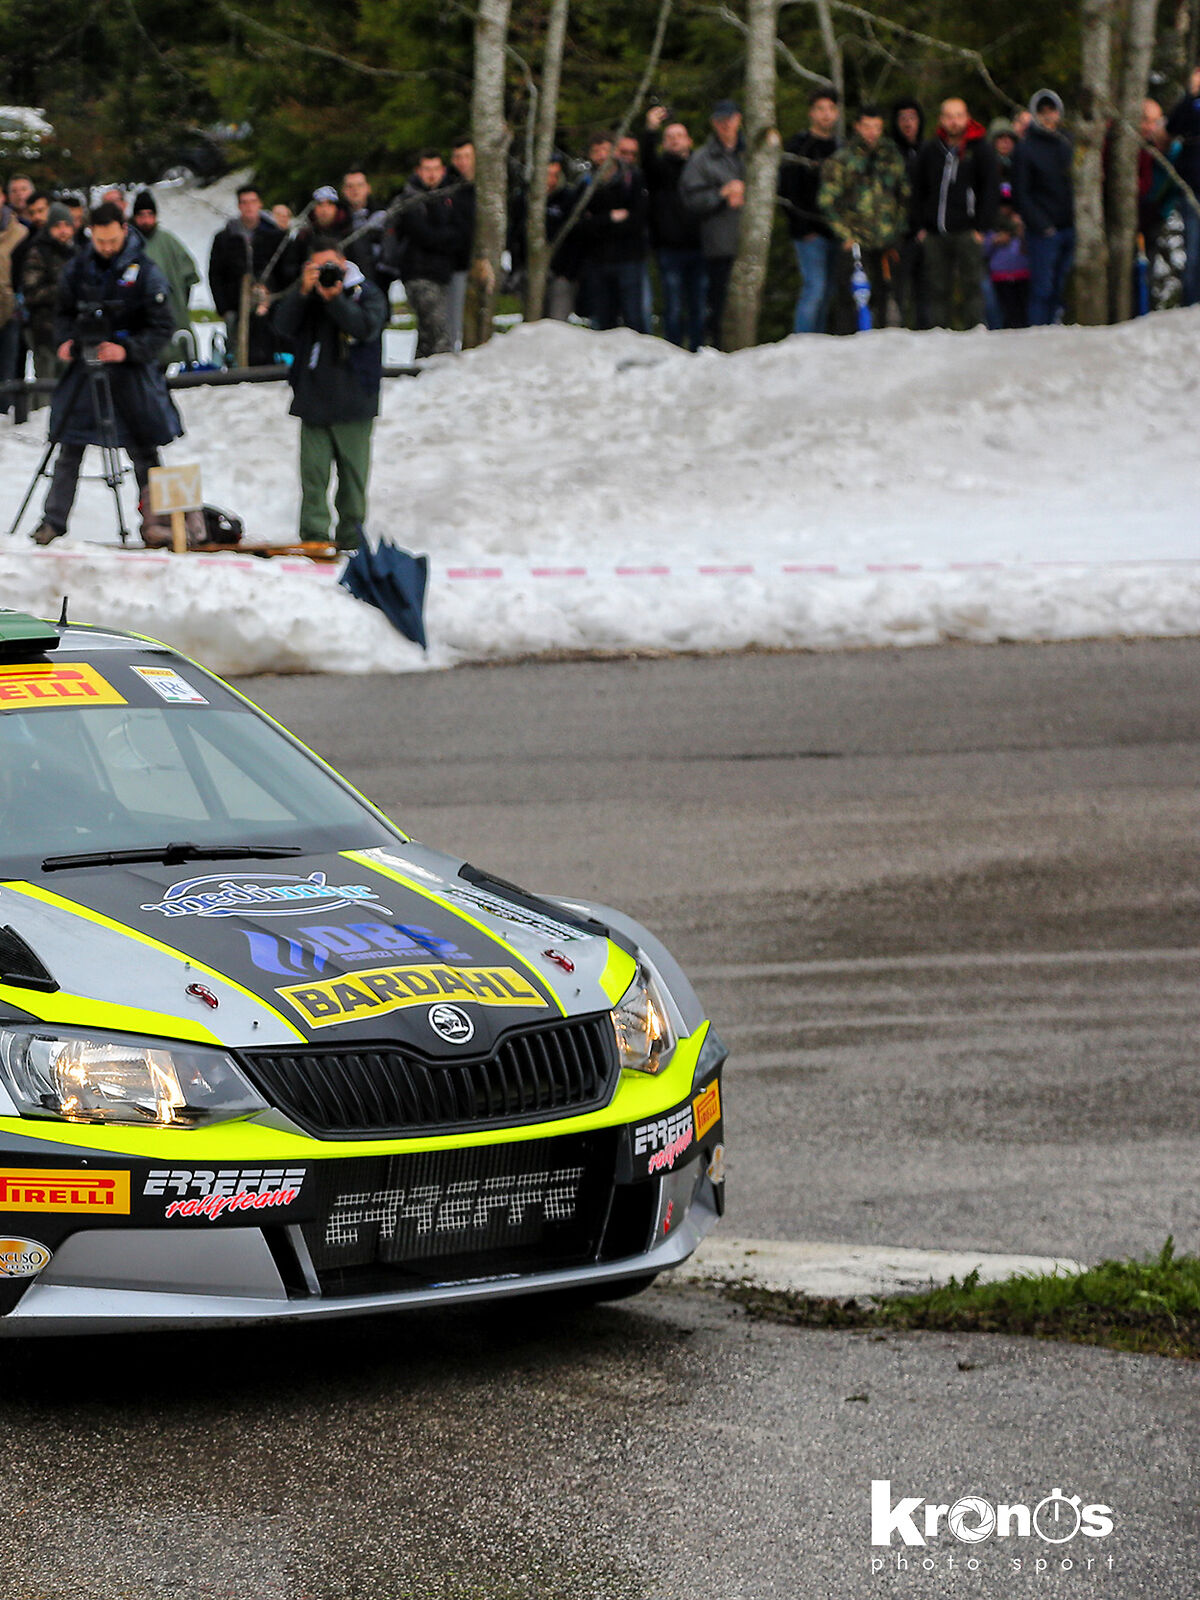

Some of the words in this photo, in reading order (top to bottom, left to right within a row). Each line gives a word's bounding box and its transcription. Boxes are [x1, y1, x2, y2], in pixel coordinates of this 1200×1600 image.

[299, 922, 459, 955] DBS
[290, 969, 538, 1018] BARDAHL
[634, 1104, 693, 1156] ERREFFE
[143, 1168, 307, 1198] ERREFFE
[324, 1167, 585, 1245] ERREFFE
